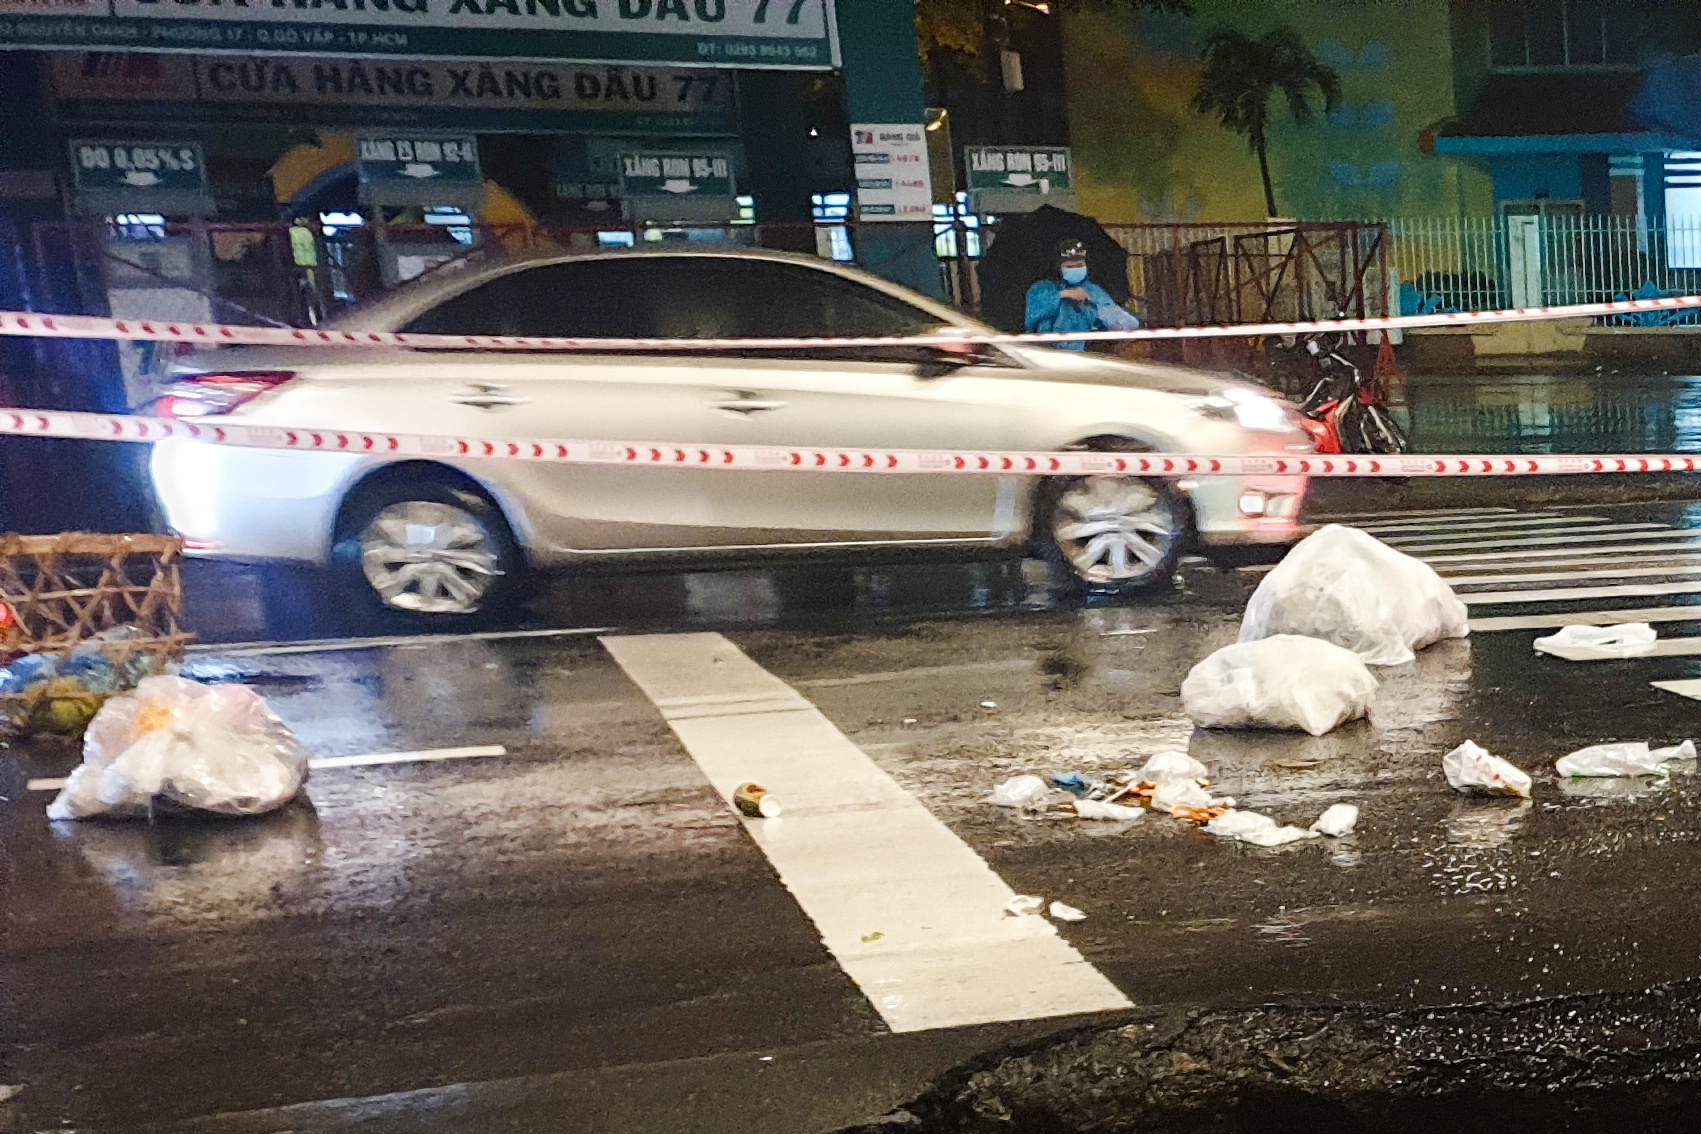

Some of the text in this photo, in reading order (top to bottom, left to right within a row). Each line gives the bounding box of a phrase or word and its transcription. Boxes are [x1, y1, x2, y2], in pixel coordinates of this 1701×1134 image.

[313, 59, 434, 97] HÀNG
[445, 59, 561, 99] XĂNG
[574, 62, 657, 101] DẦU
